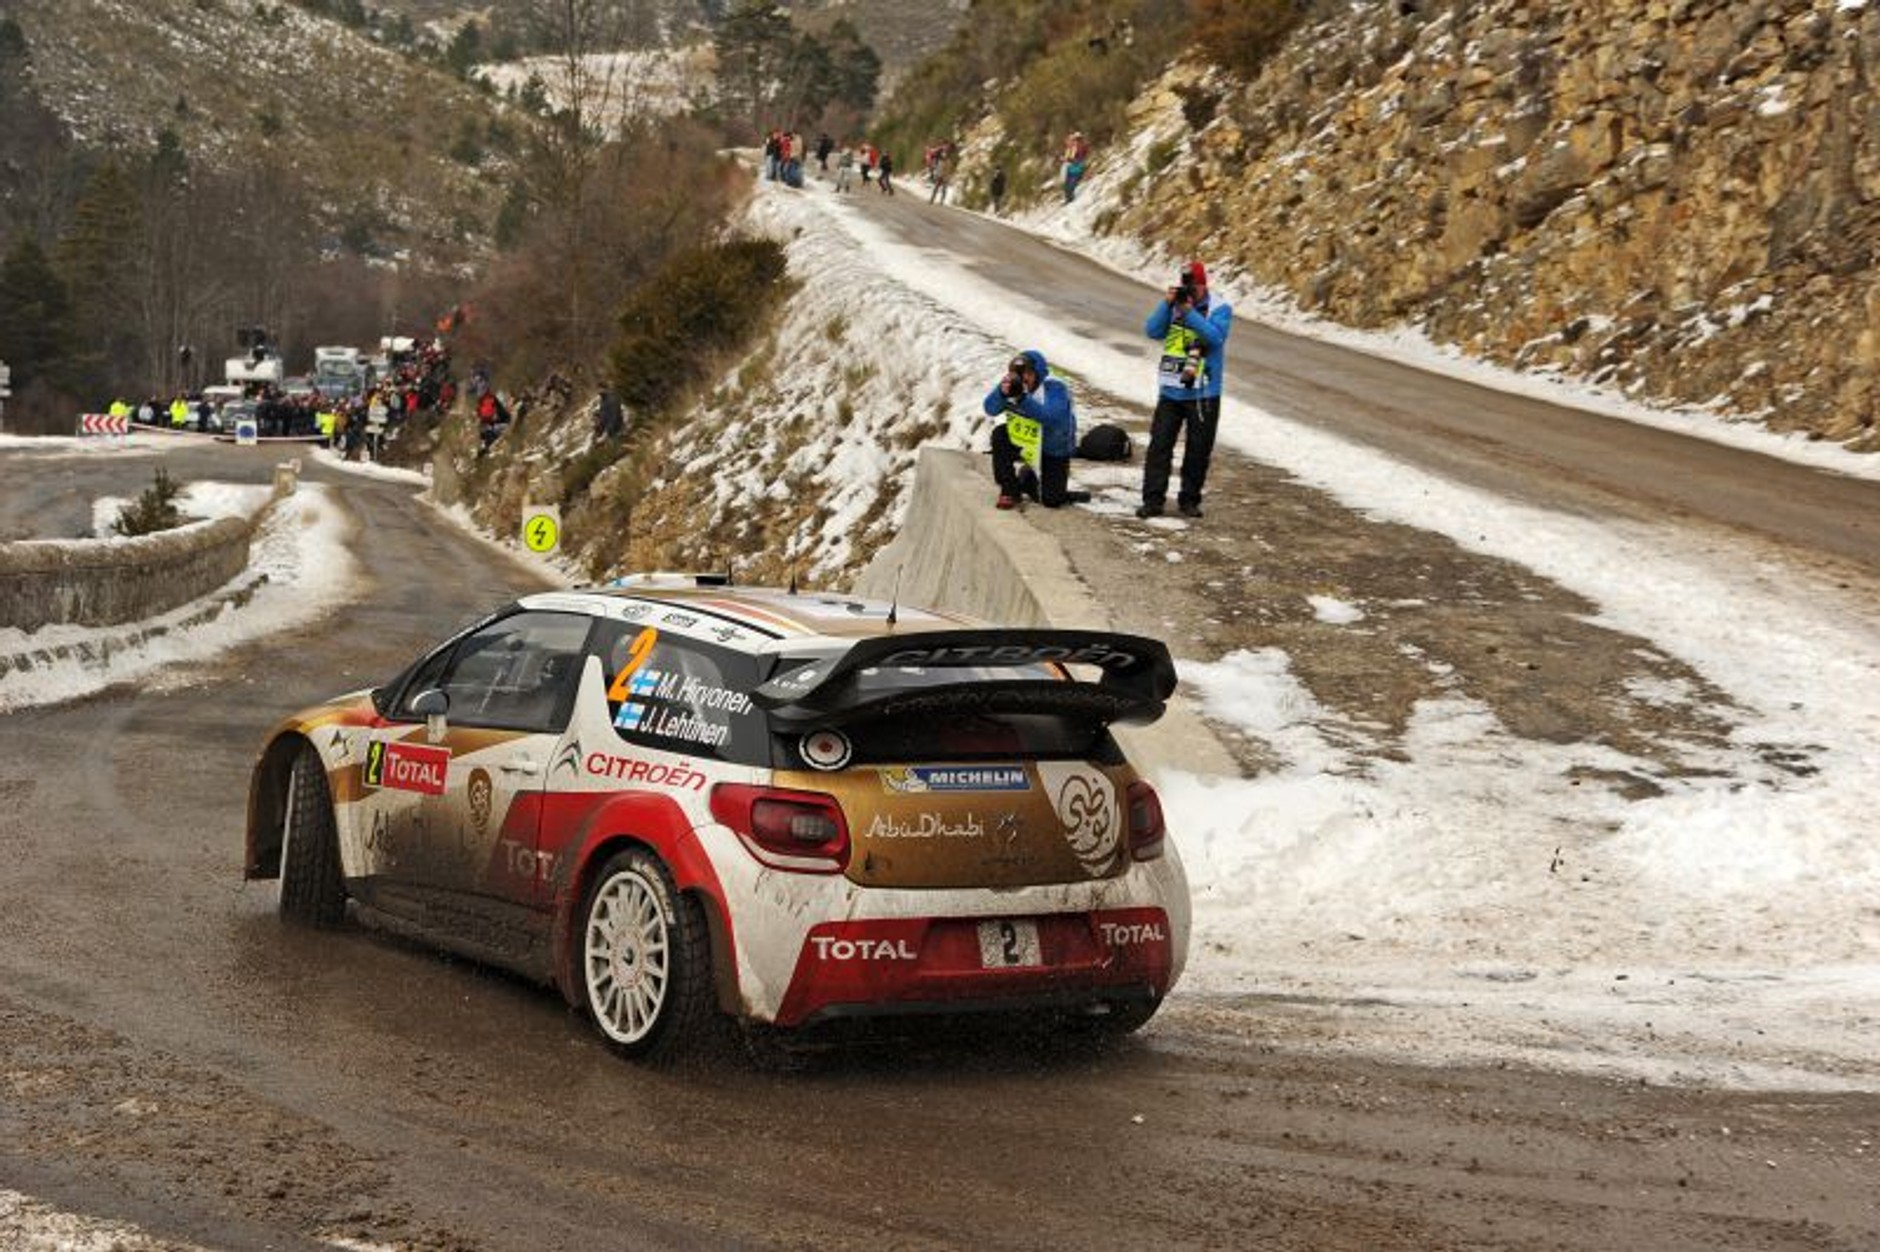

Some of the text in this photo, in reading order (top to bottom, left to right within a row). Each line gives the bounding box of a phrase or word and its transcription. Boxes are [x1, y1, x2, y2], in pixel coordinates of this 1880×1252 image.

[608, 627, 659, 703] 2
[656, 672, 677, 699] M.
[681, 676, 754, 714] Hirvonen
[641, 711, 728, 746] J. Lehtinen
[367, 743, 382, 783] 2
[387, 755, 443, 787] TOTAL
[929, 769, 1024, 785] MICHELIN
[811, 935, 918, 961] TOTAL
[1000, 924, 1018, 965] 2
[1100, 922, 1164, 947] TOTAL
